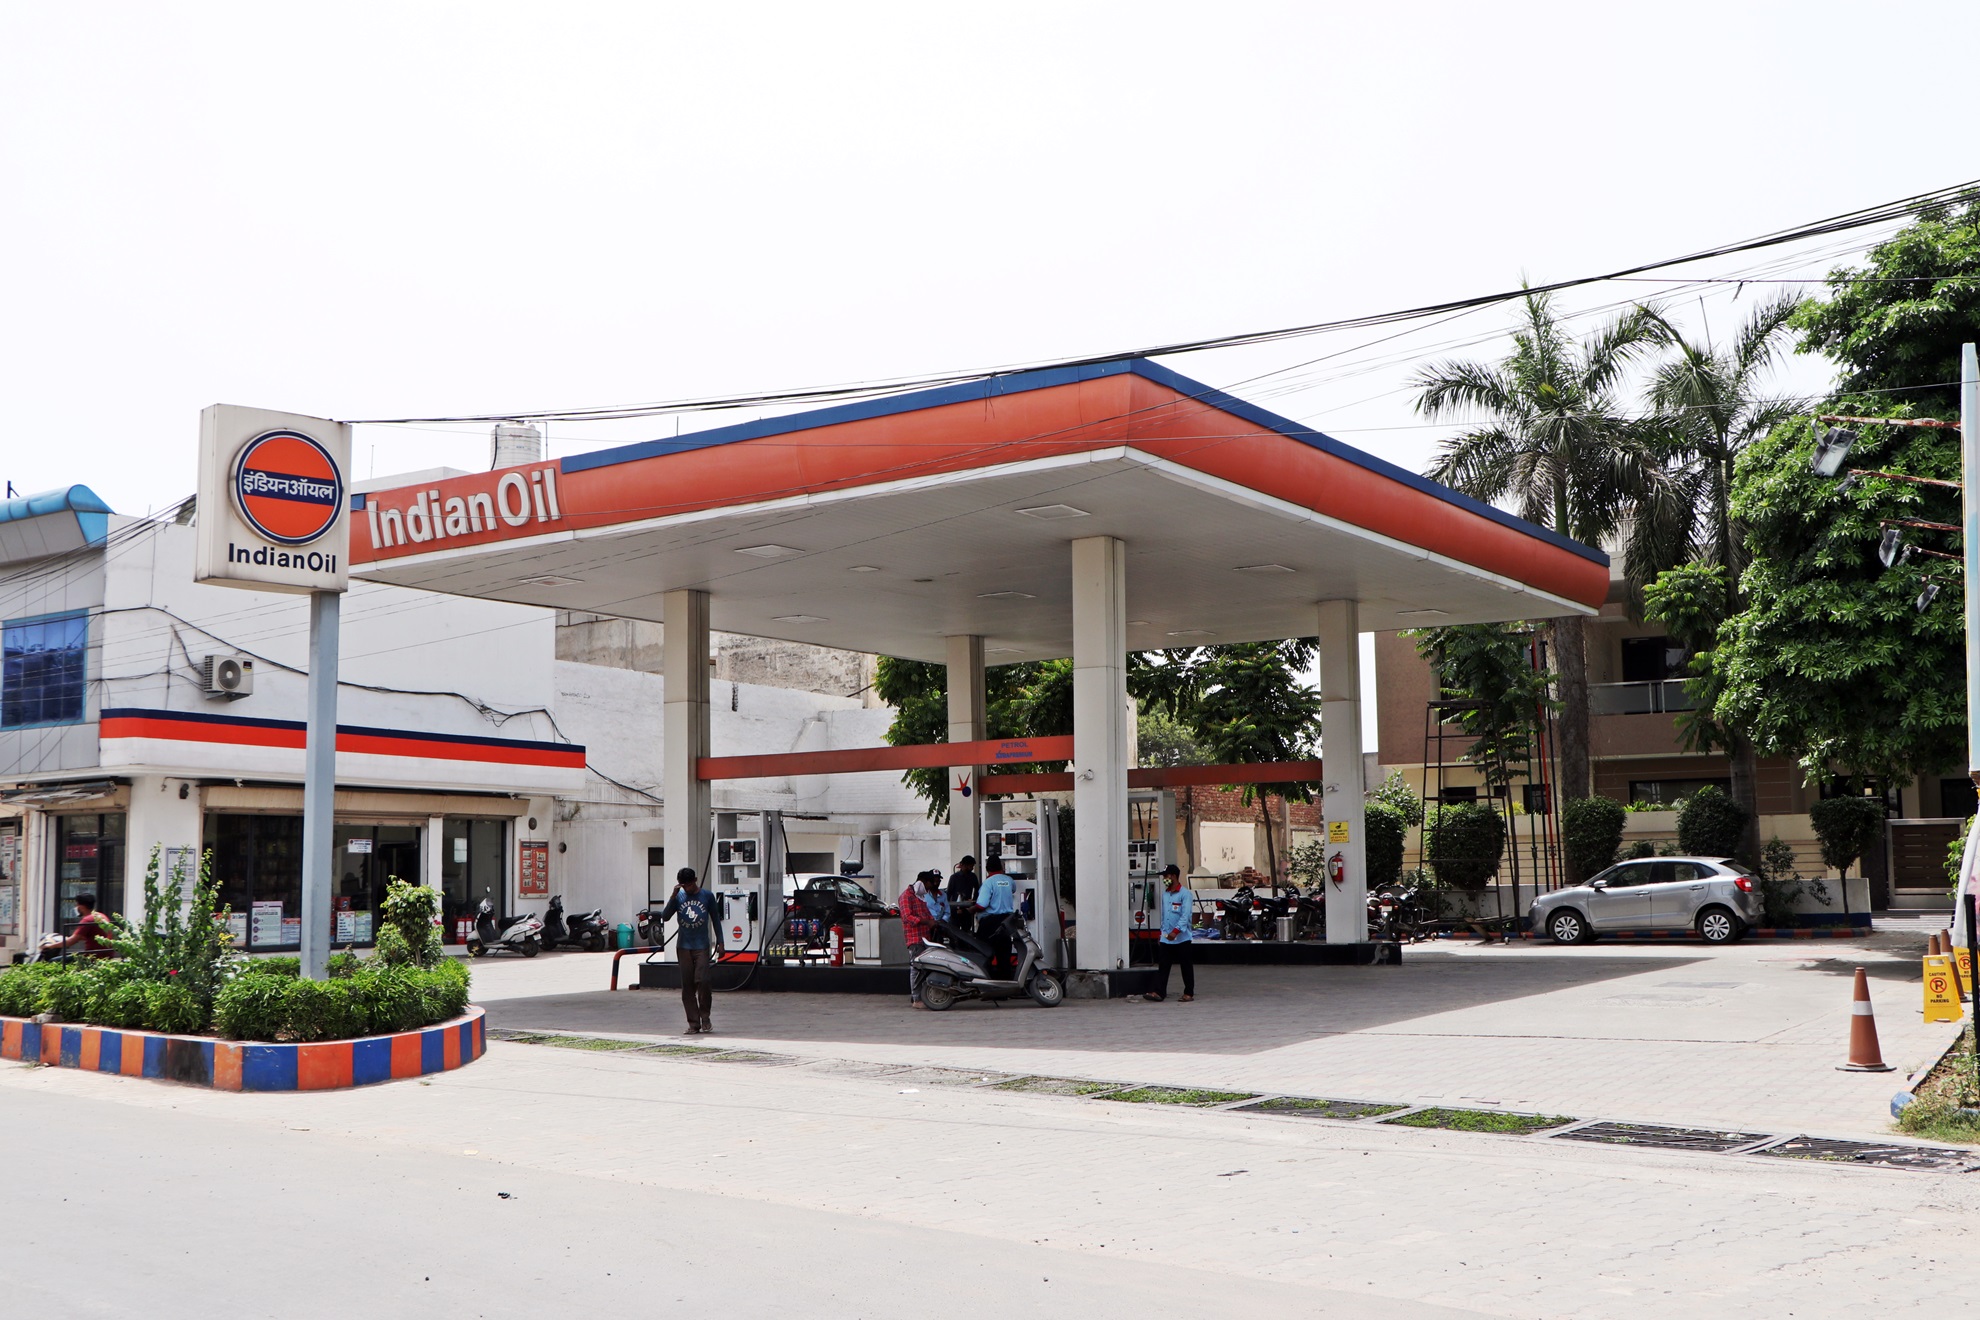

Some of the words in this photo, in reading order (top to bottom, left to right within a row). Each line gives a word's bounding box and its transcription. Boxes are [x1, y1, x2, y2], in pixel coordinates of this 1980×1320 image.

[243, 471, 334, 499] इंडियनऑयल
[366, 467, 561, 549] IndianOil
[228, 543, 336, 573] IndianOil
